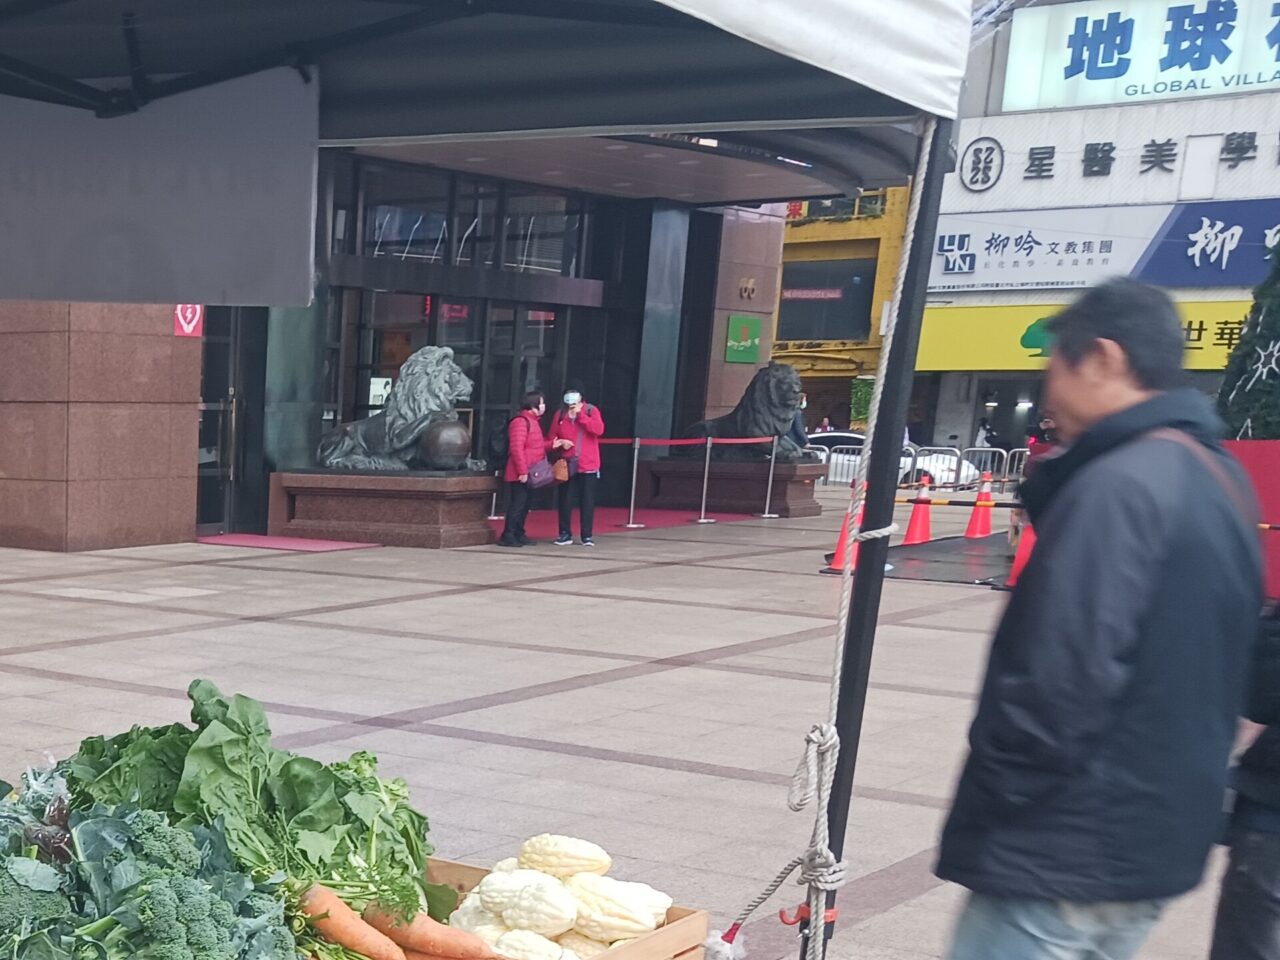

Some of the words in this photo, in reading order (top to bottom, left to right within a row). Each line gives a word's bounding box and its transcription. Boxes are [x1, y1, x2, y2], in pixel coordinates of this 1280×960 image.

[1124, 78, 1211, 96] GLOBAL
[1023, 131, 1280, 180] 星醫美學
